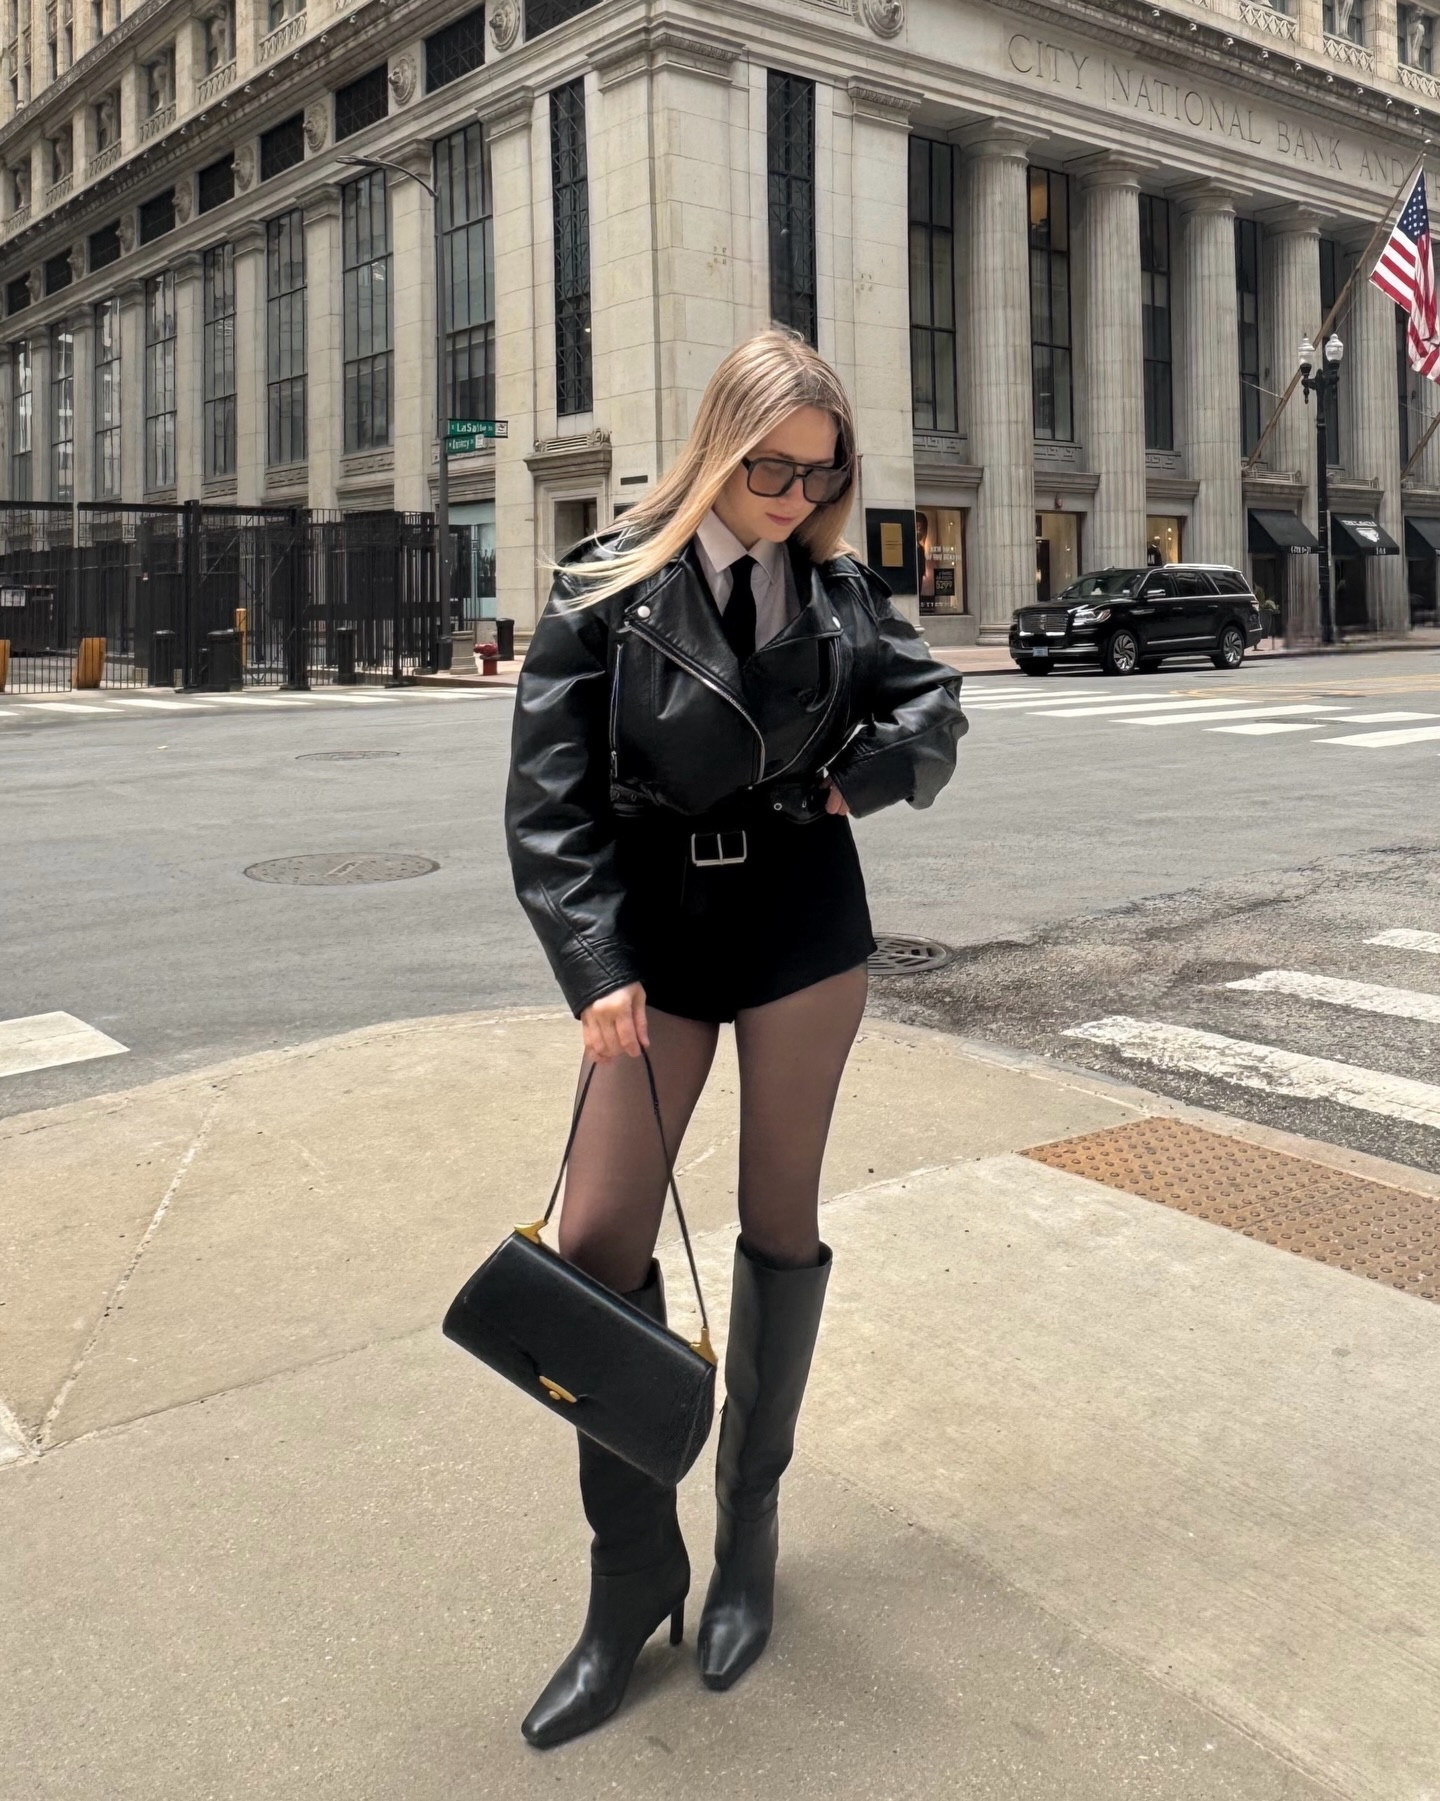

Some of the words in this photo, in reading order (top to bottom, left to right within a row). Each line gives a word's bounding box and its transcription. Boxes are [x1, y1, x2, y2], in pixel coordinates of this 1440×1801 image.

[1008, 33, 1090, 90] CITY
[1111, 64, 1262, 145] NATIONAL
[1276, 119, 1344, 171] BANK
[1359, 149, 1405, 188] AND
